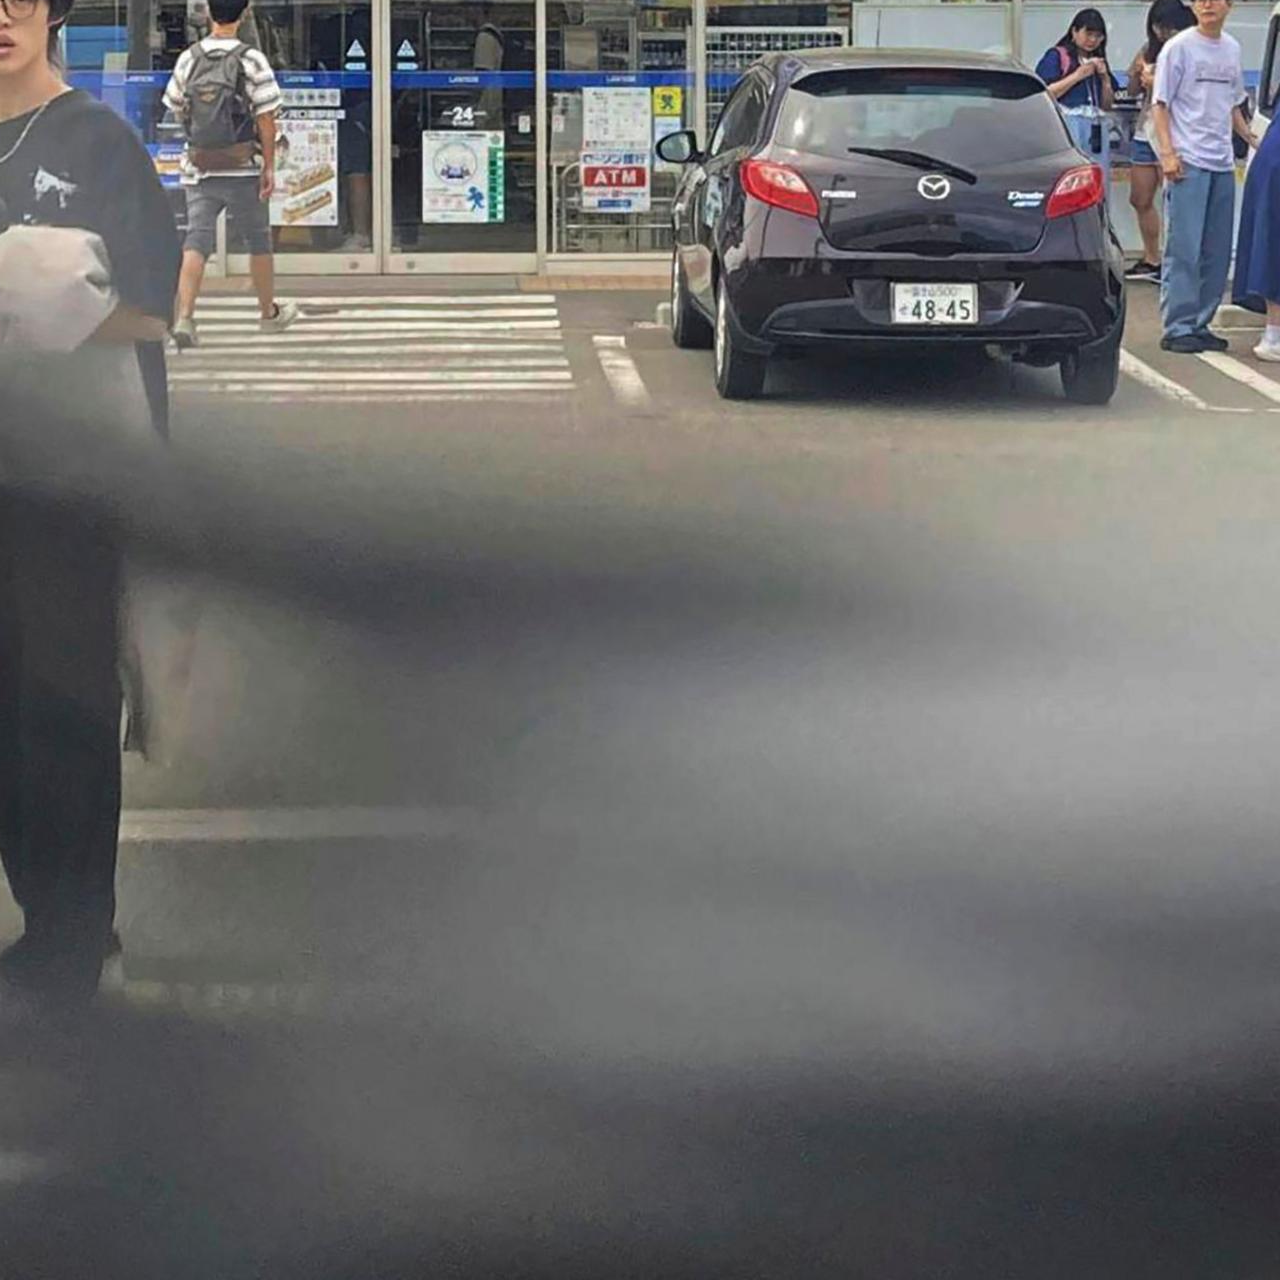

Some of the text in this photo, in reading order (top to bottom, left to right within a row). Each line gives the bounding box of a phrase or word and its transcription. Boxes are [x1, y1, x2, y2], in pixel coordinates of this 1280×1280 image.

[452, 106, 474, 121] 24
[593, 170, 637, 185] ATM
[912, 300, 971, 321] 48-45
